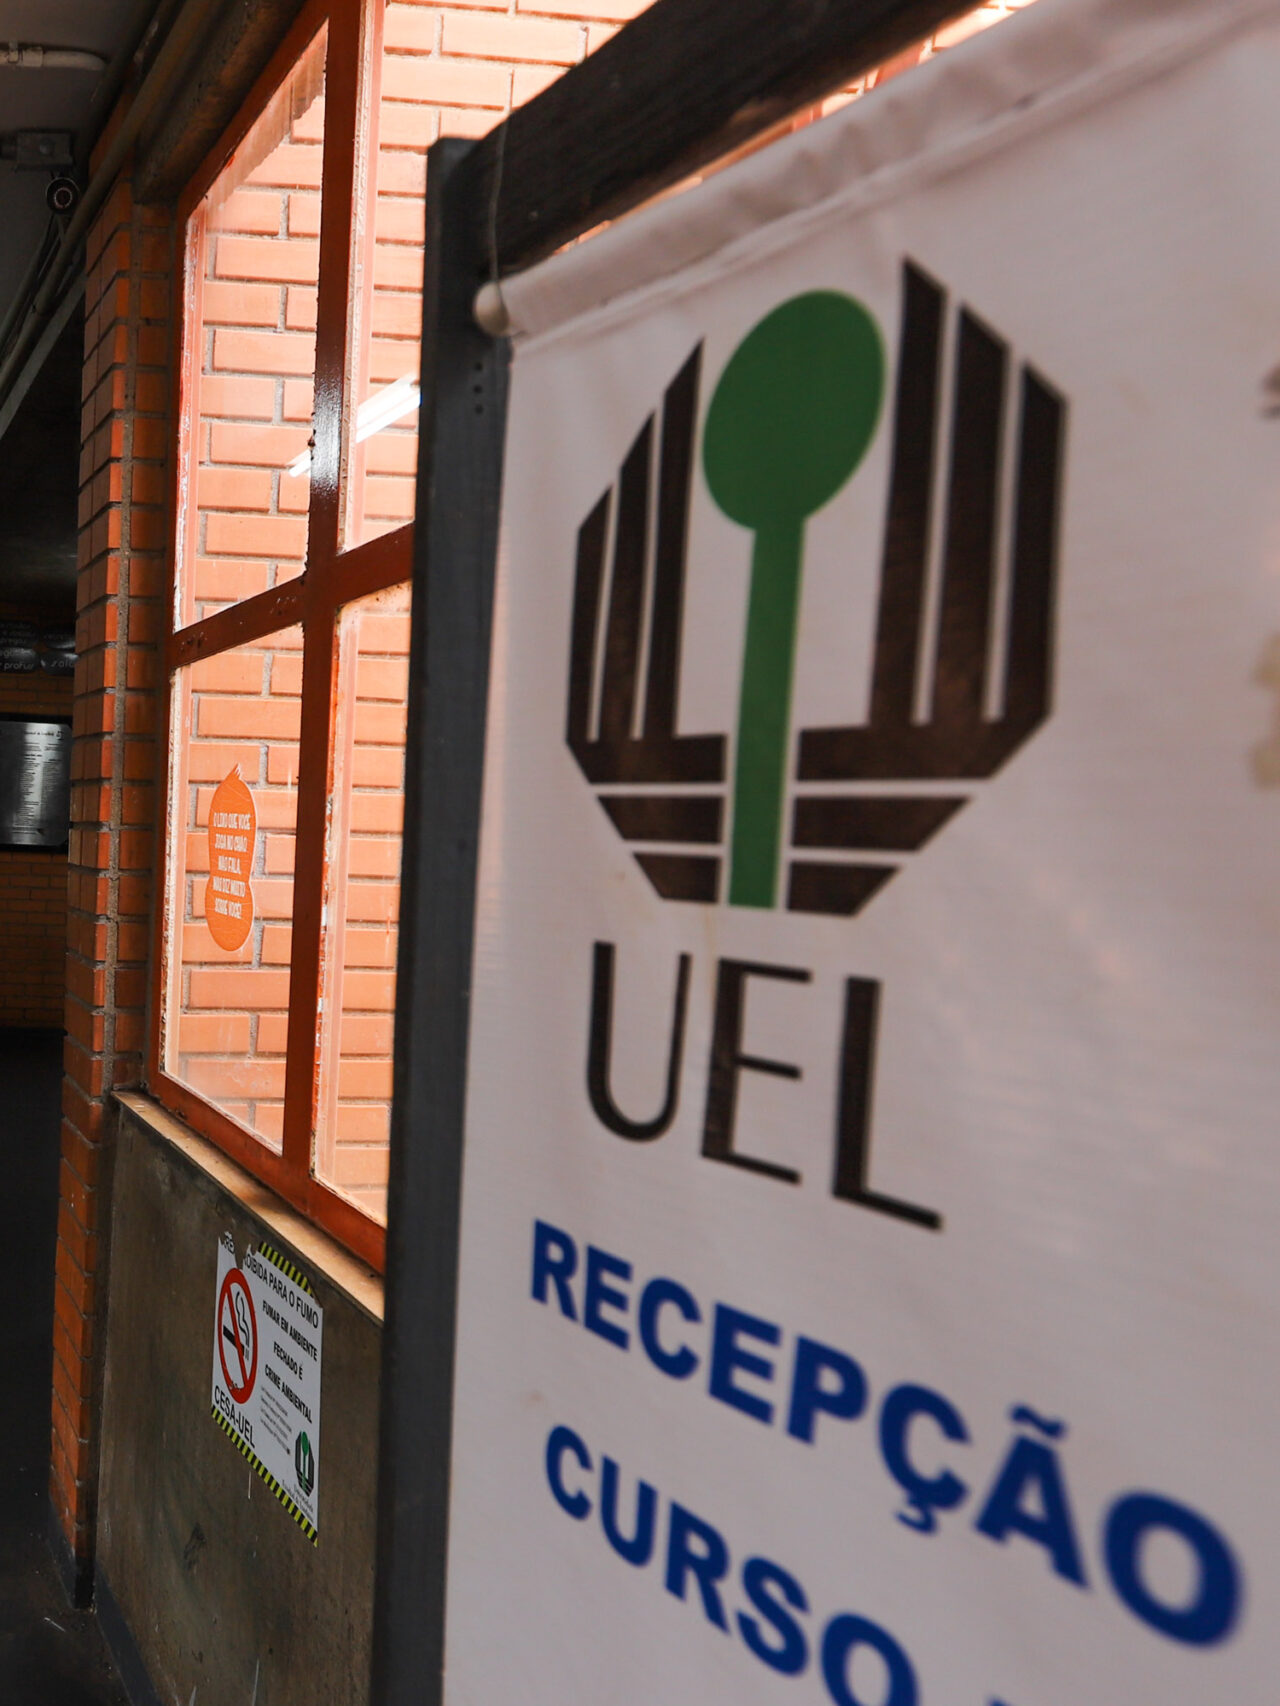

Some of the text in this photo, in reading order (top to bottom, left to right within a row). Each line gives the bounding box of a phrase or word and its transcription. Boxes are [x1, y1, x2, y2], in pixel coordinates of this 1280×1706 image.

[586, 940, 943, 1232] UEL
[263, 1300, 318, 1362] FUMAR EM AMBIENTE
[269, 1272, 288, 1302] PARA
[289, 1289, 295, 1308] O
[296, 1295, 319, 1329] FUMO
[273, 1341, 304, 1380] FECHADO É
[214, 1385, 255, 1448] CESA-UEL
[264, 1364, 281, 1390] CRIME
[281, 1382, 313, 1424] AMBIENTAL
[531, 1218, 1244, 1650] RECEPÇÃO
[544, 1424, 923, 1706] CURSO
